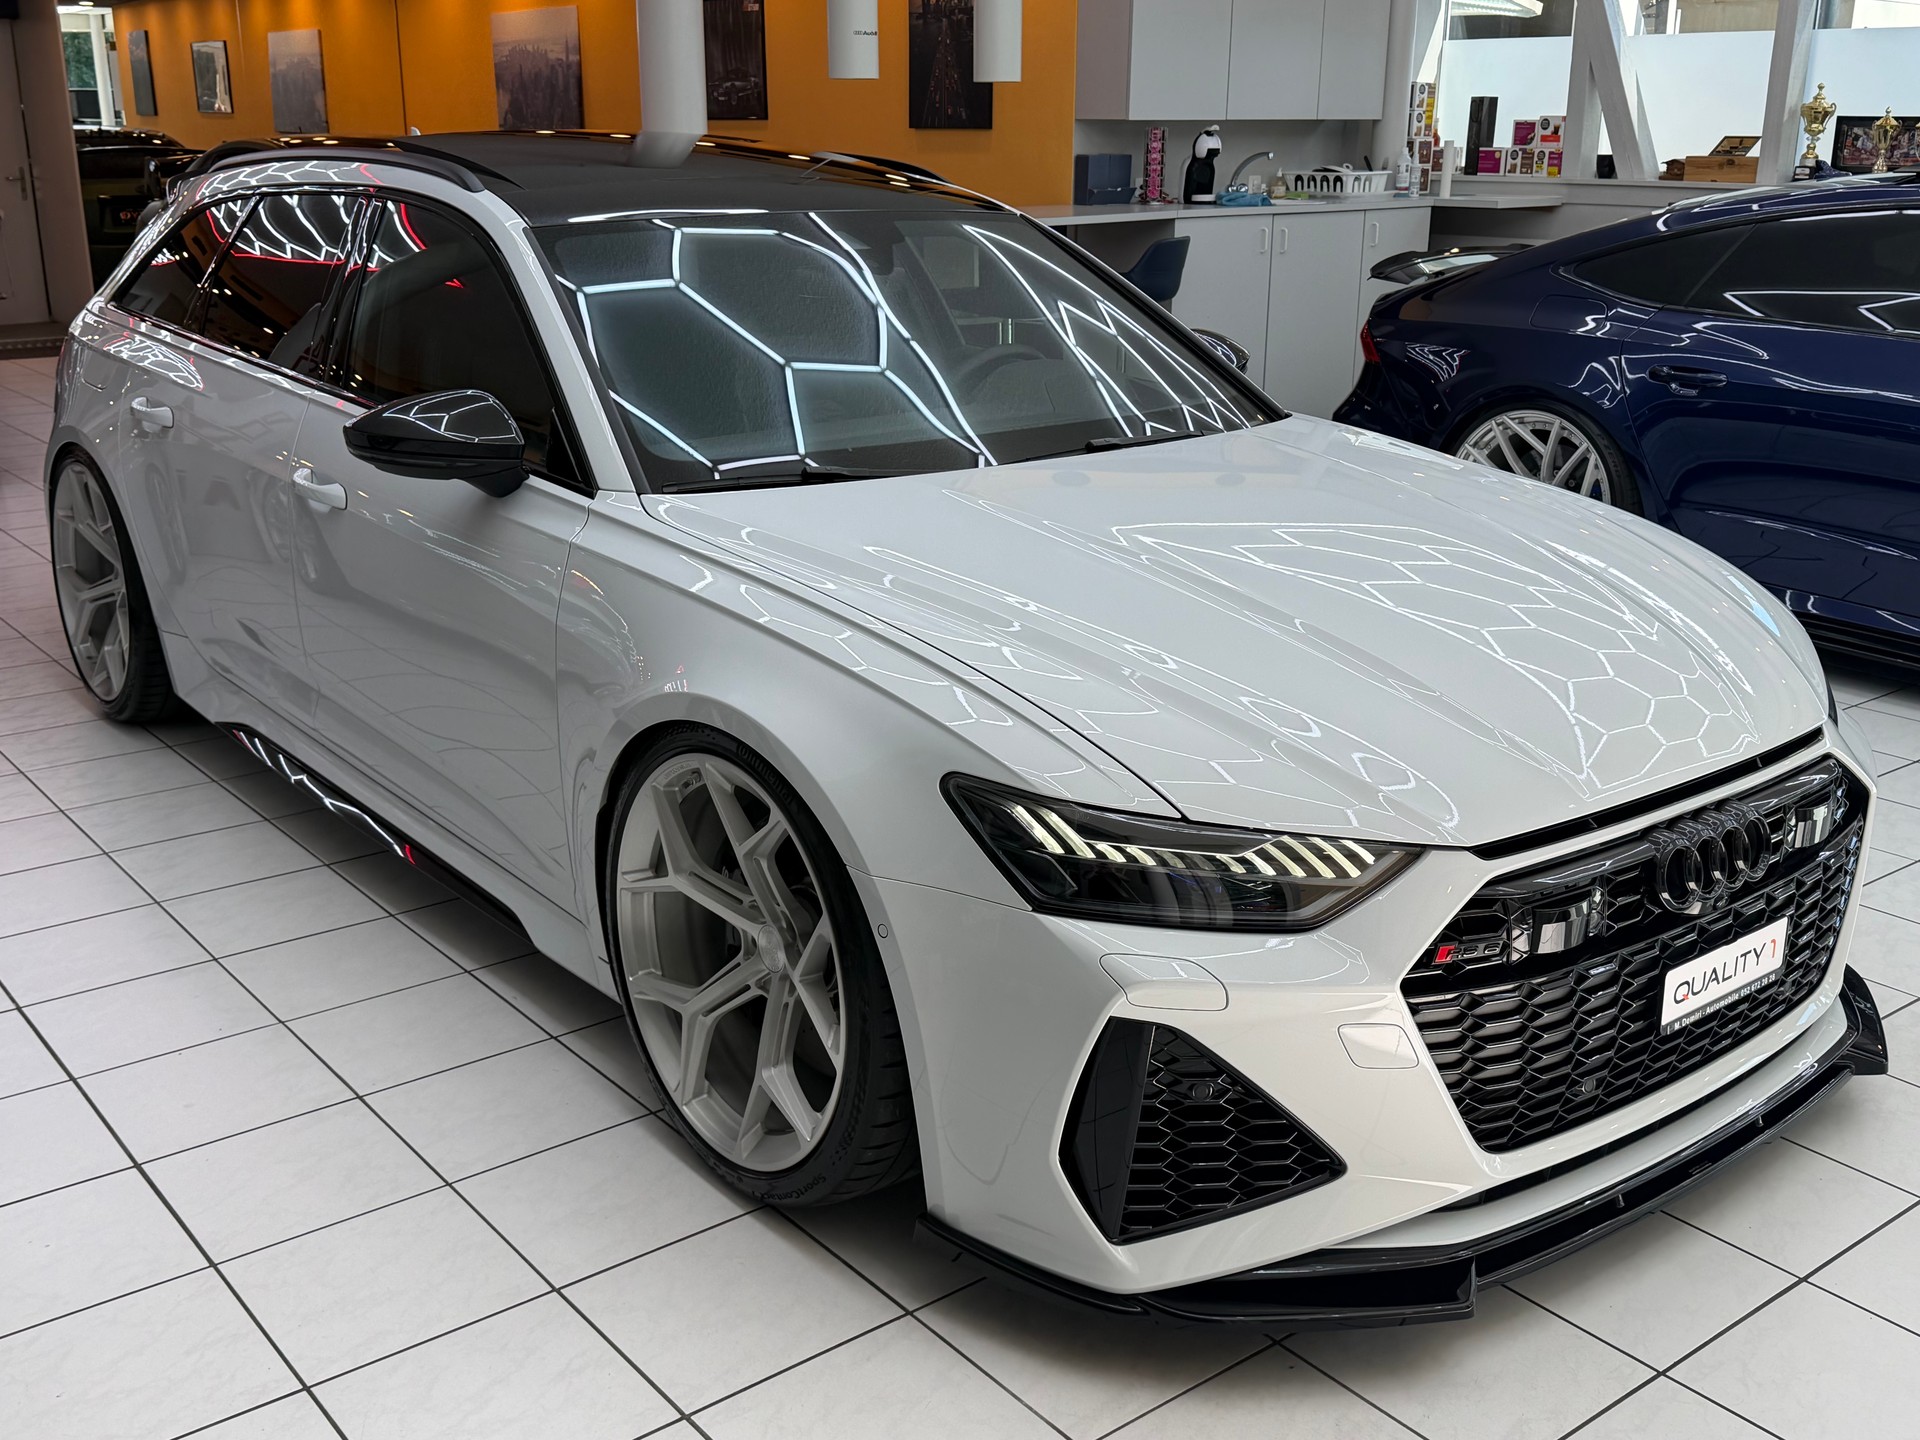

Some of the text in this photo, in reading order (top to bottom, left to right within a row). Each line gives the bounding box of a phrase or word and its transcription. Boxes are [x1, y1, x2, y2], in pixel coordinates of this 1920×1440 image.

[1673, 938, 1777, 1004] QUALITY 1
[1705, 992, 1739, 1016] Automobile
[1740, 987, 1750, 997] 052
